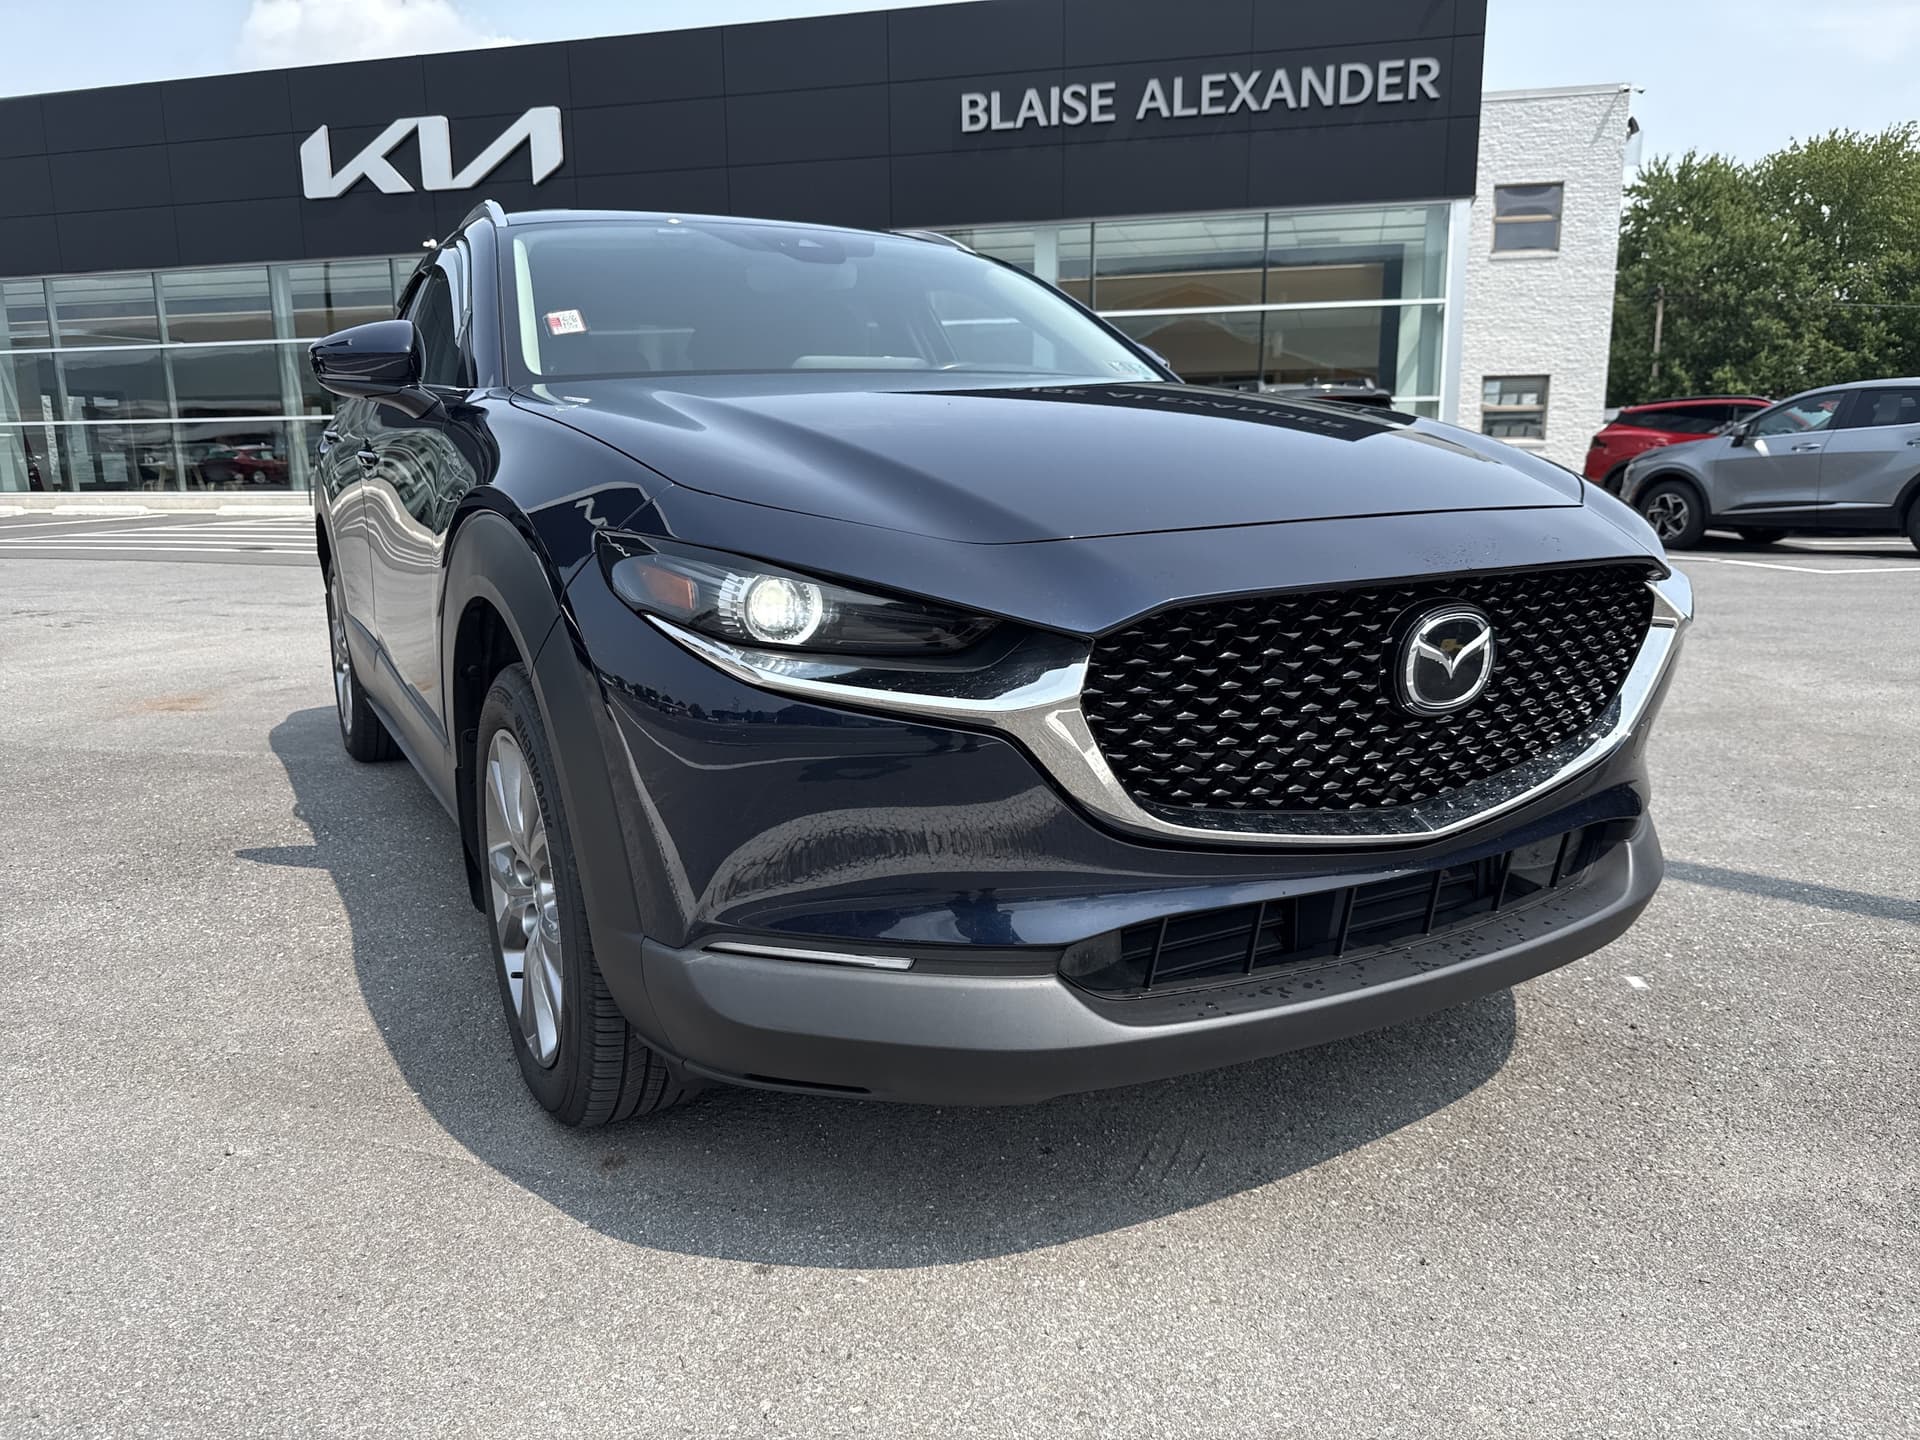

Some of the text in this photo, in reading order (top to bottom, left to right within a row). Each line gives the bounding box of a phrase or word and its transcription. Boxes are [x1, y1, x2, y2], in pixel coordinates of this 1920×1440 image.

[960, 57, 1441, 133] BLAISE ALEXANDER
[300, 105, 564, 200] KIA
